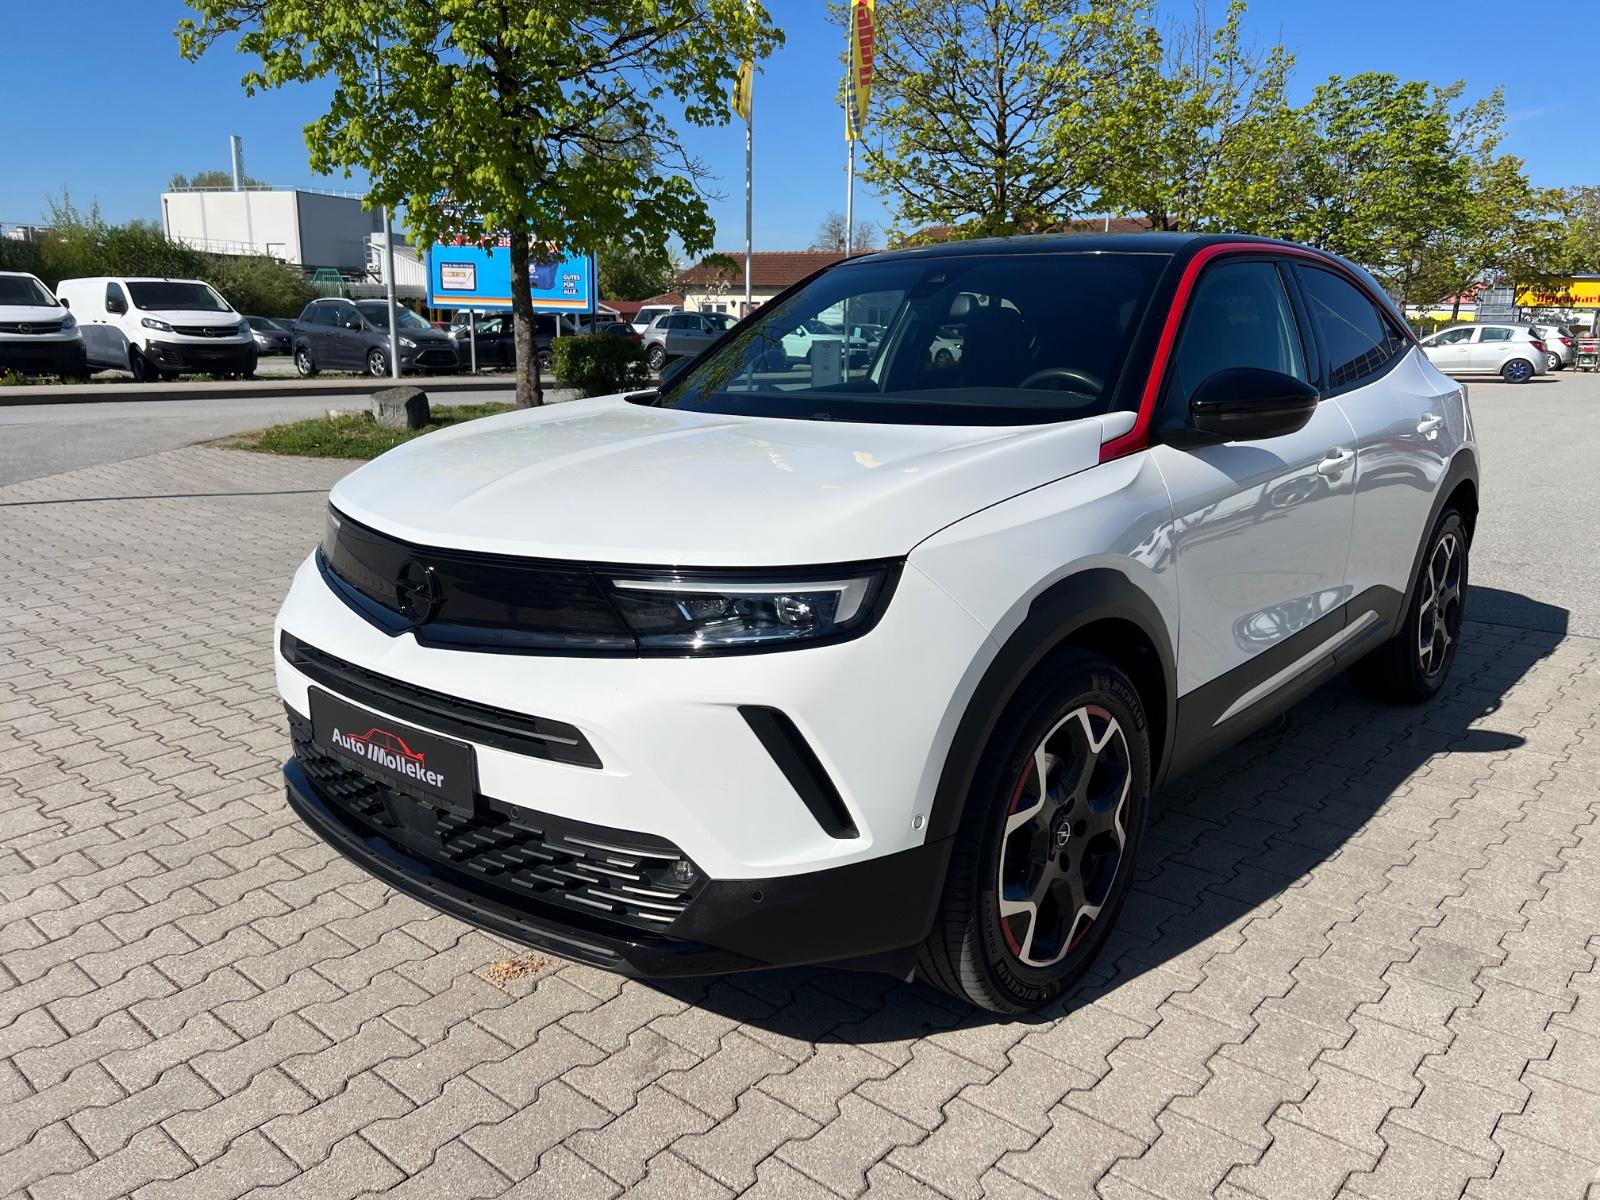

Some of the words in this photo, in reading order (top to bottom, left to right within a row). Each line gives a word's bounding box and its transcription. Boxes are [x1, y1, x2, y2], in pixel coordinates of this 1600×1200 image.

[1112, 681, 1144, 729] MICHELIN
[332, 728, 365, 756] Auto
[994, 961, 1041, 1002] MICHELIN
